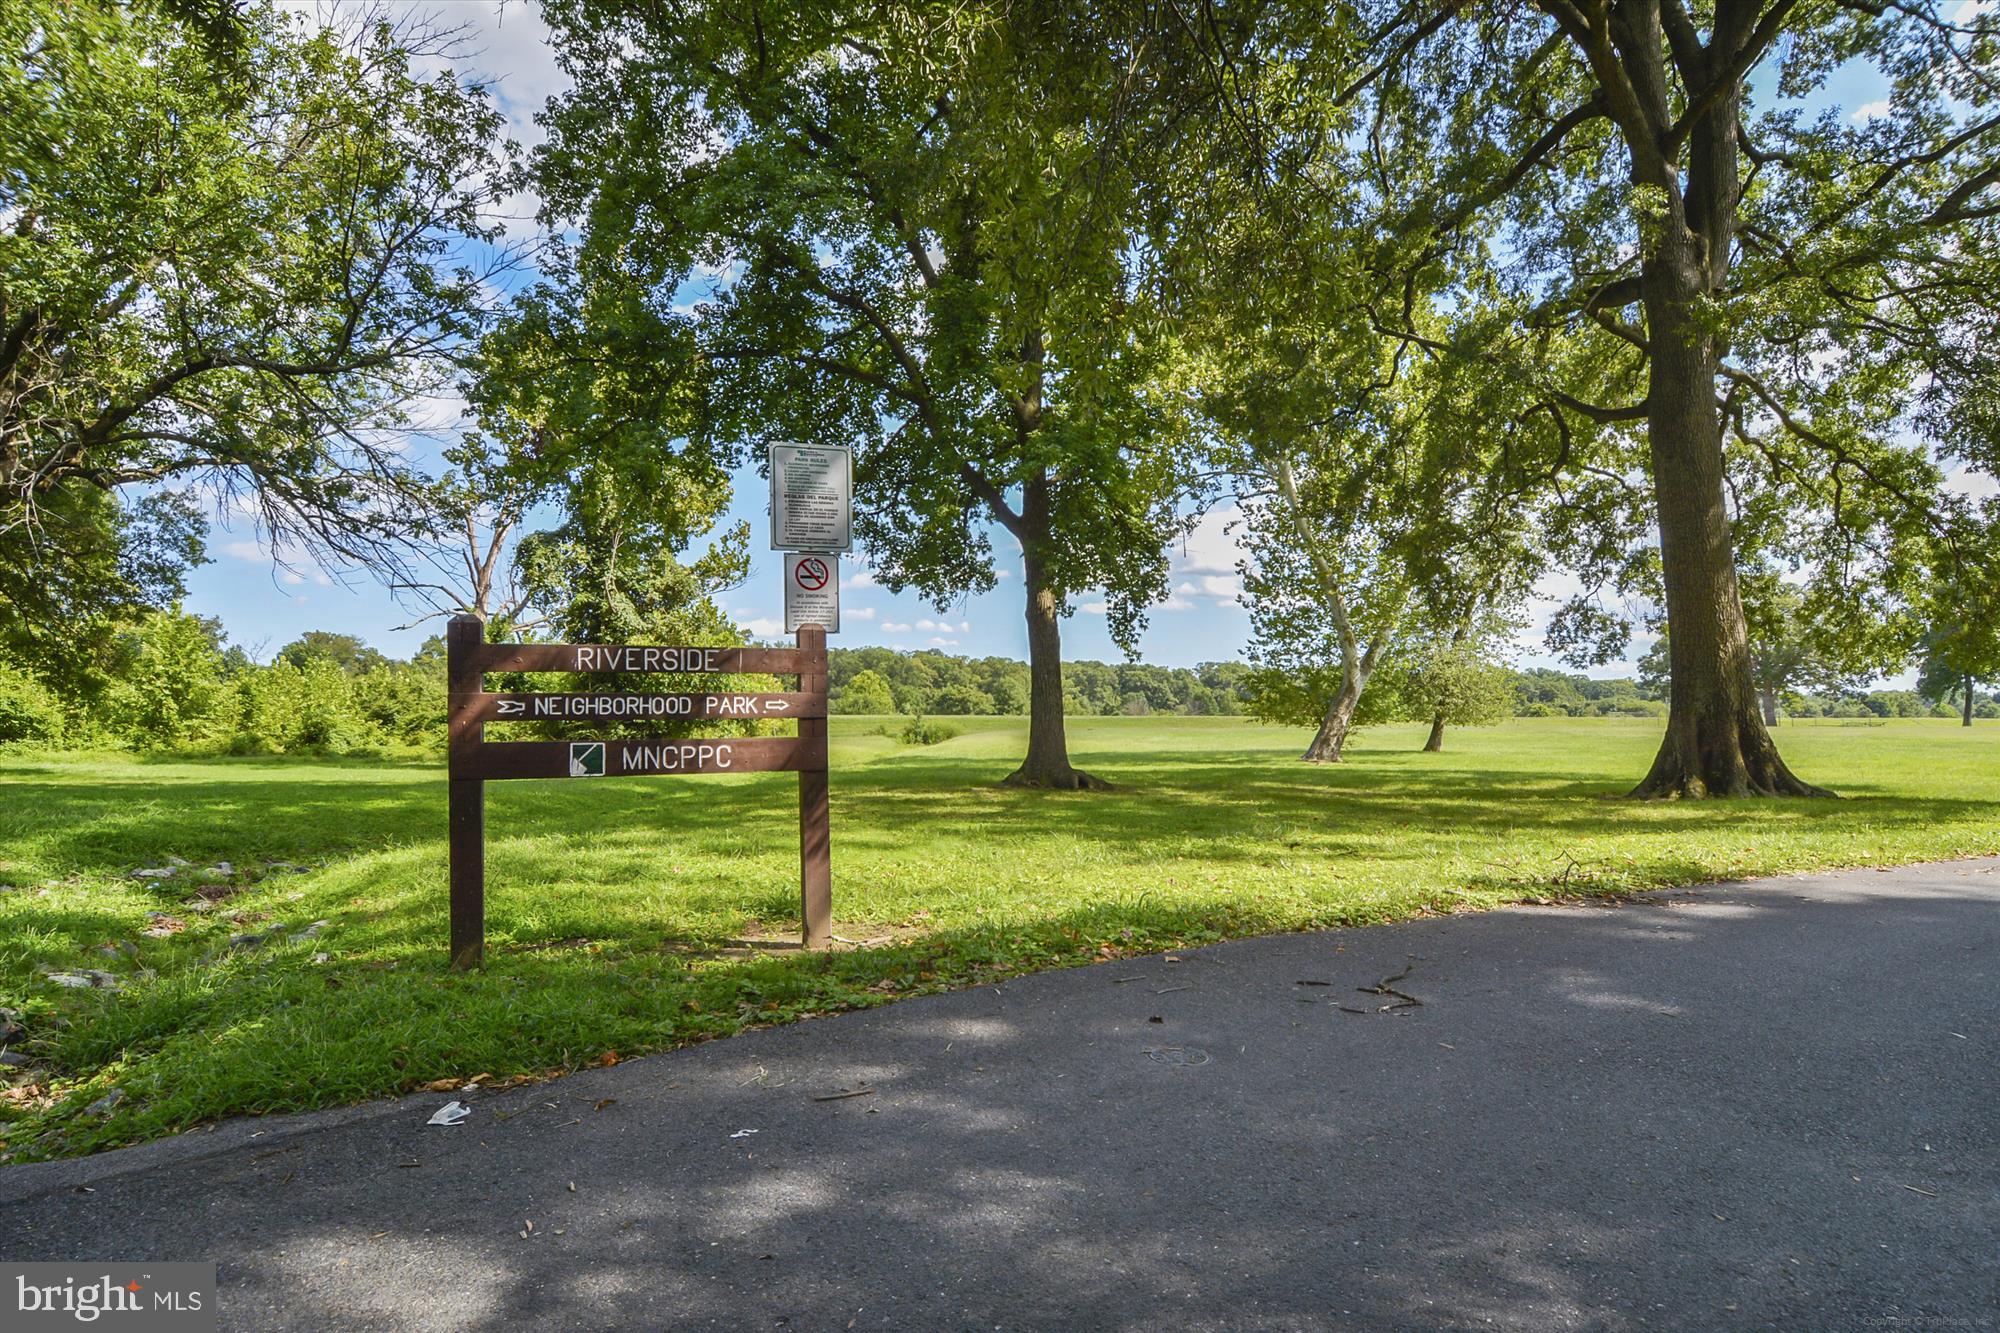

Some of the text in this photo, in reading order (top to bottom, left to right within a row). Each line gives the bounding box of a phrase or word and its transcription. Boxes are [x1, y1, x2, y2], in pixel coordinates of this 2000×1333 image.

[576, 647, 720, 672] RIVERSIDE
[534, 695, 758, 716] NEIGHBORHOOD PARK
[622, 745, 732, 771] MNCPPC
